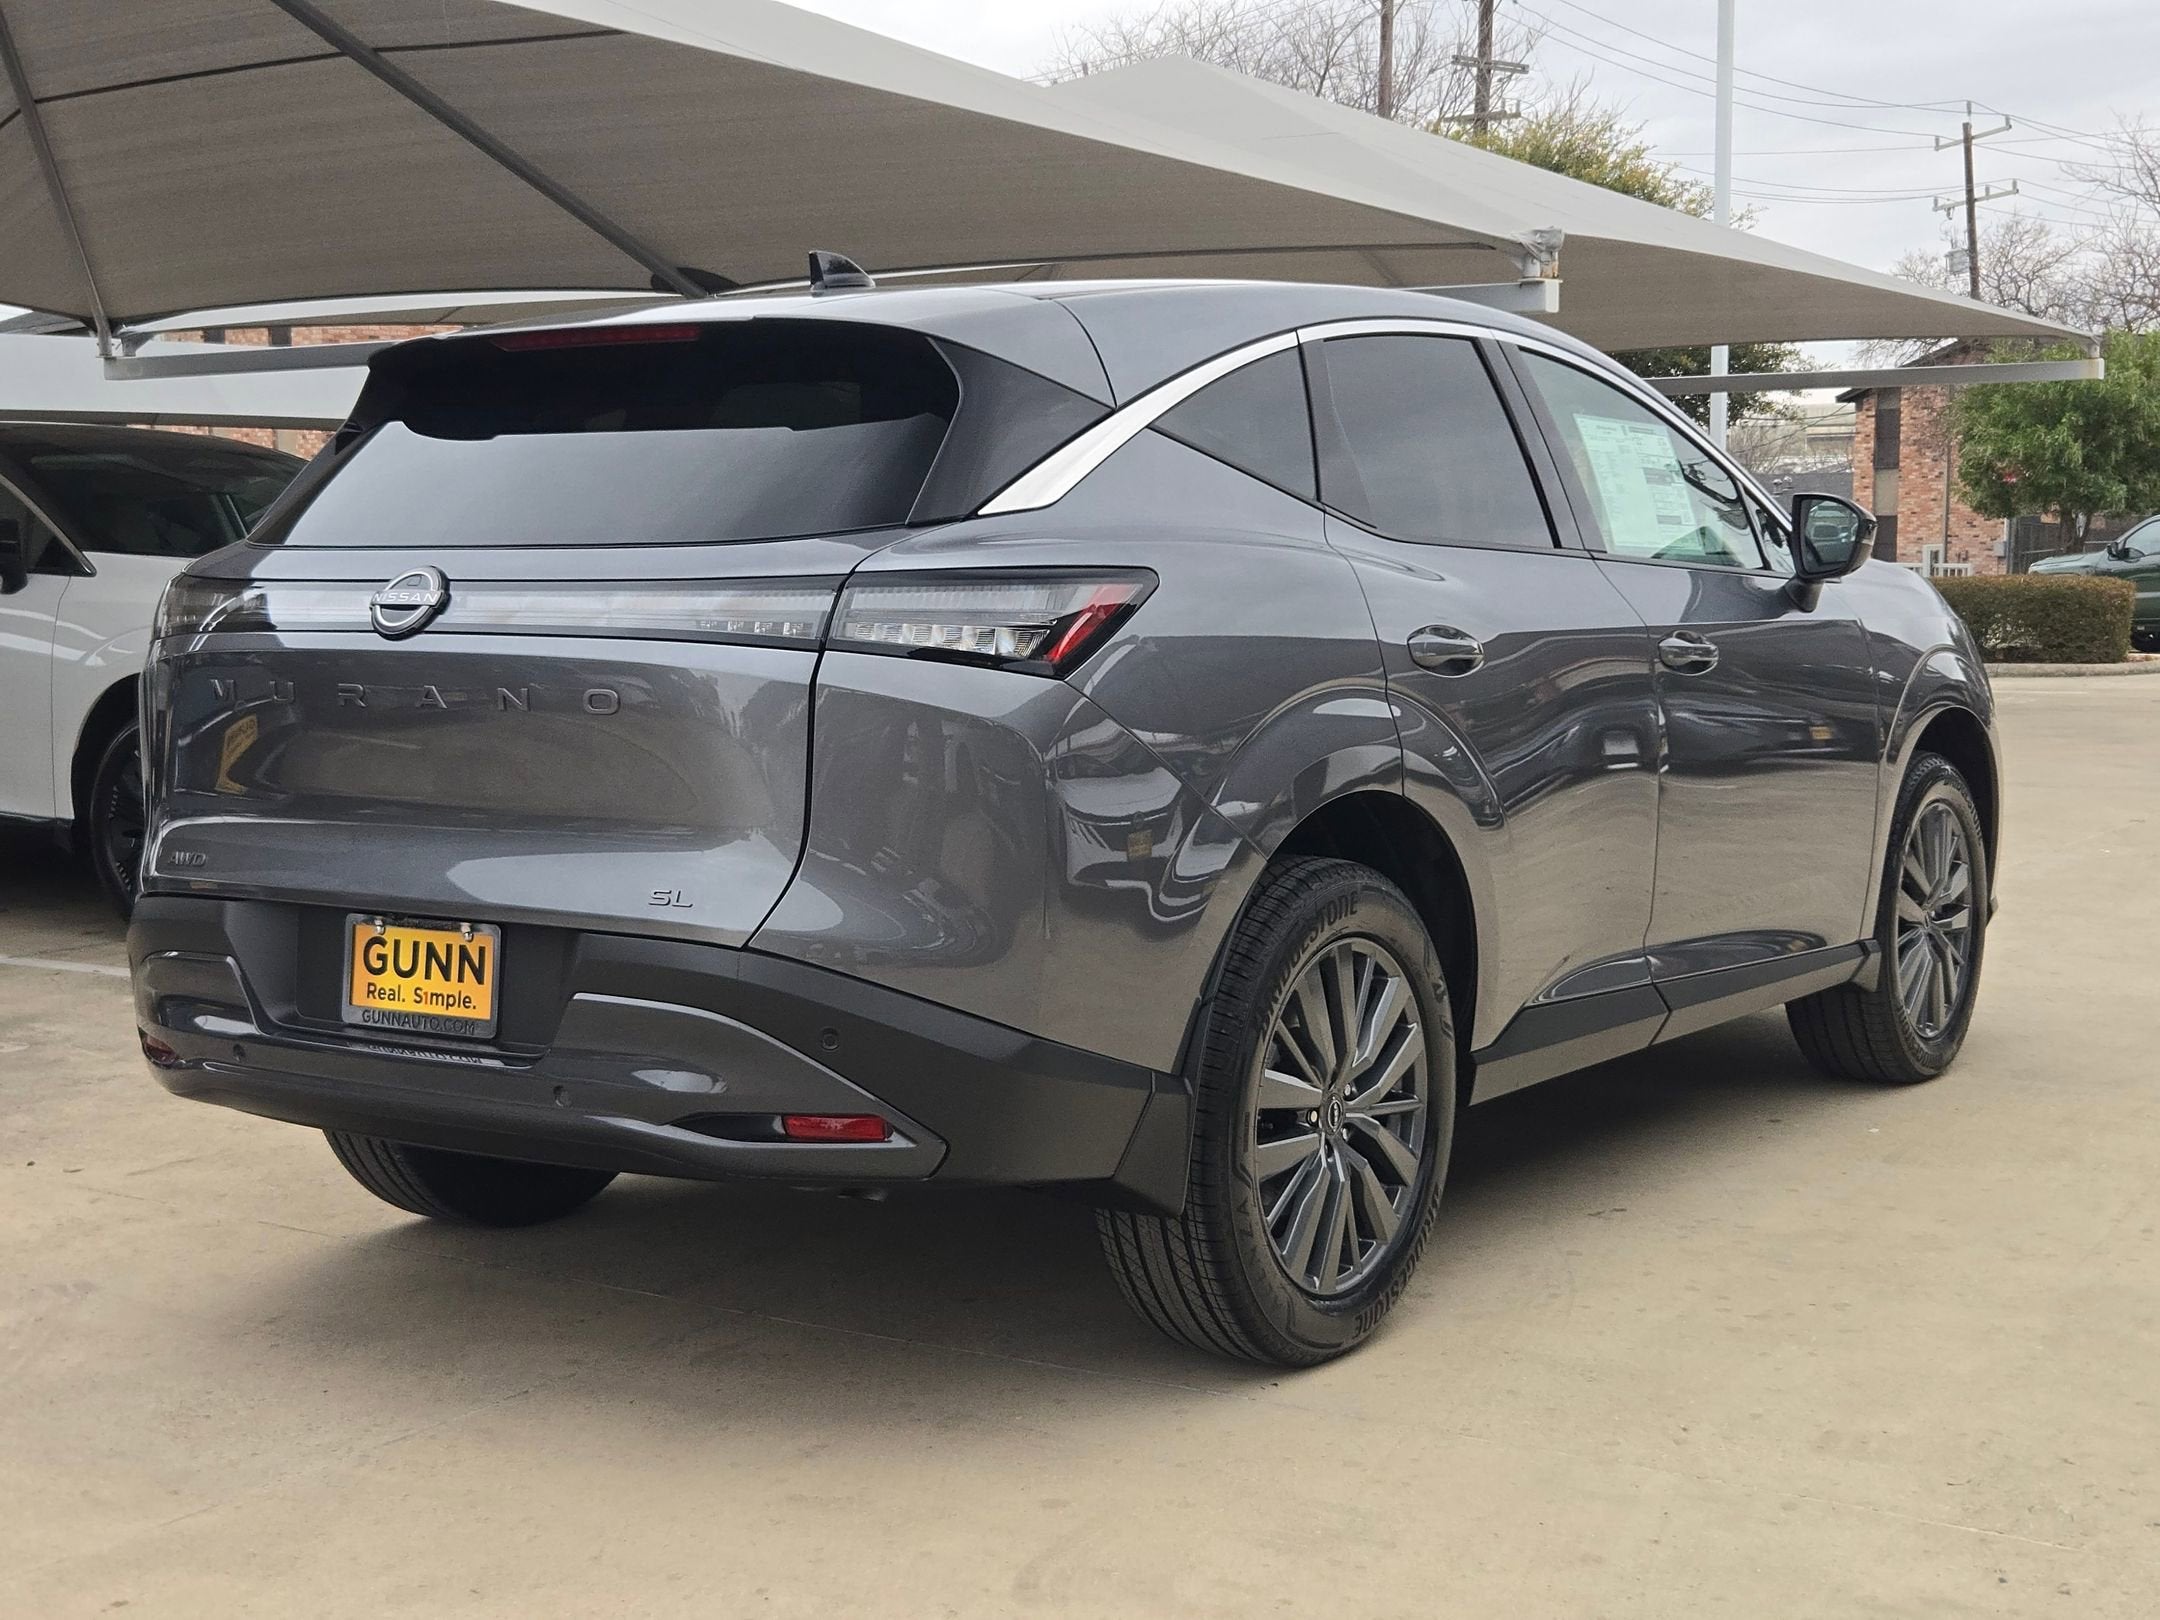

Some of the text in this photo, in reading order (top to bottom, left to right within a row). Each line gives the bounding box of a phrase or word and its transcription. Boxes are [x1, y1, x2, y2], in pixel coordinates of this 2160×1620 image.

[373, 592, 438, 603] NISSAN
[211, 679, 621, 715] MURANO
[648, 889, 694, 908] SL
[363, 936, 486, 985] GUNN
[366, 982, 406, 1003] Real.
[361, 1009, 475, 1036] GUNNAUTO.COM
